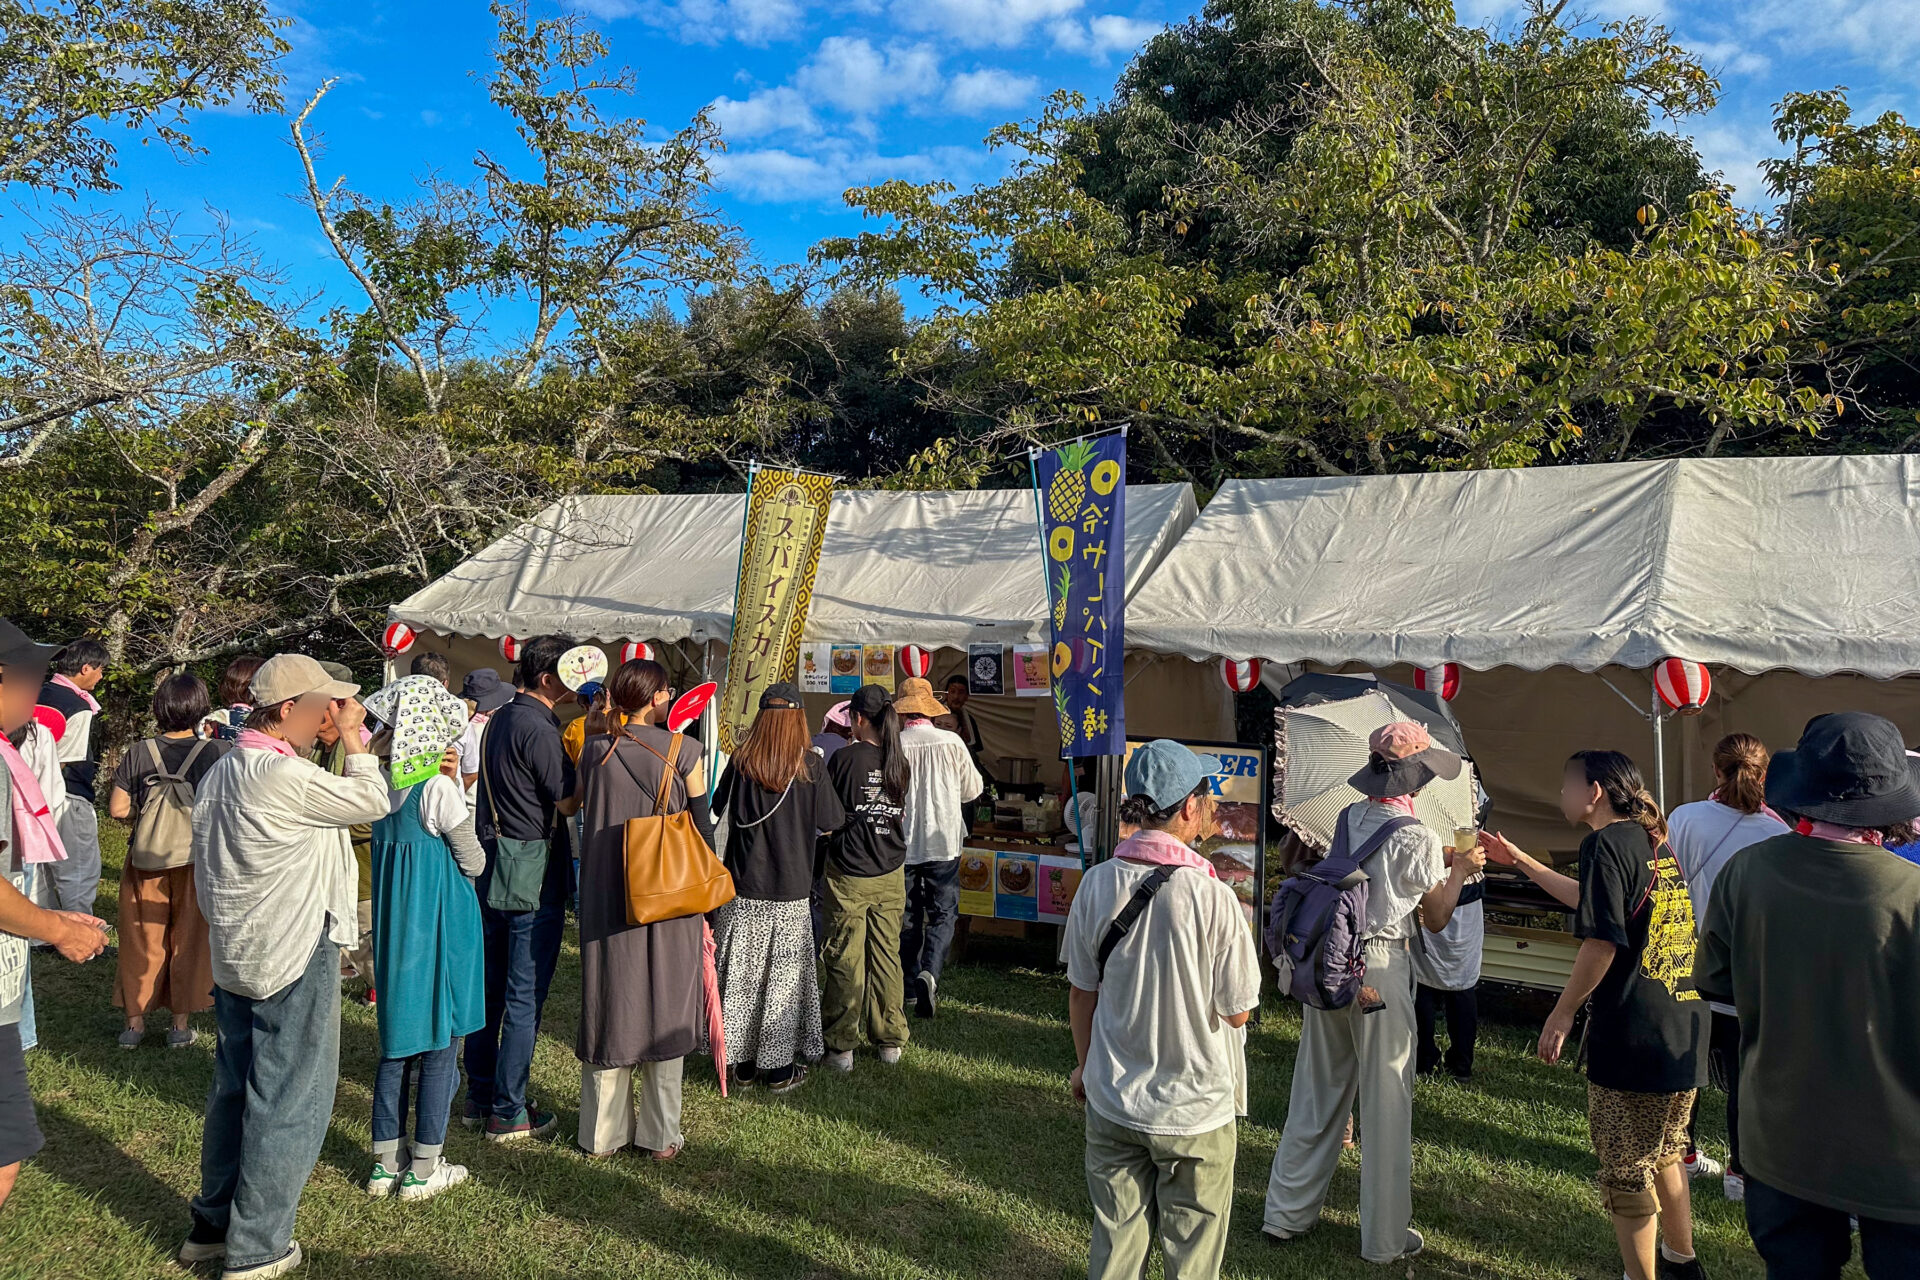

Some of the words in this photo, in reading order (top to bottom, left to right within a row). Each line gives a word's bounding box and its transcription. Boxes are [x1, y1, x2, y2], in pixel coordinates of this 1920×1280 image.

[755, 538, 765, 563] Curry
[796, 543, 806, 570] Please
[747, 567, 759, 609] Delicious
[742, 516, 794, 715] スパイスカレー
[784, 596, 793, 614] Very
[743, 615, 752, 633] Very
[772, 620, 787, 661] Delicious
[733, 662, 741, 687] Please
[1203, 752, 1259, 777] ER
